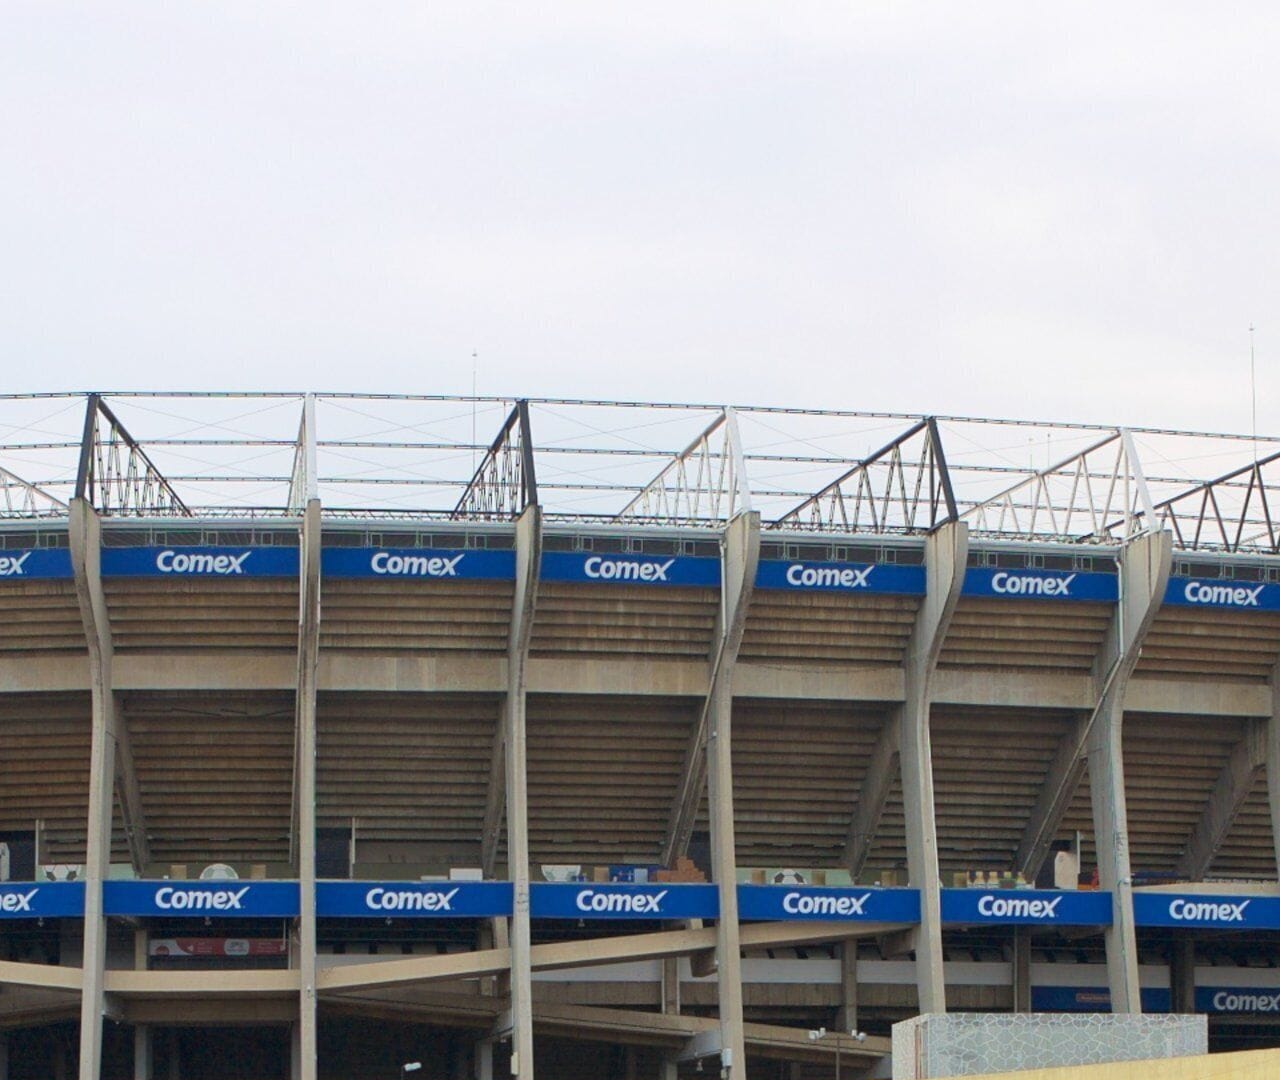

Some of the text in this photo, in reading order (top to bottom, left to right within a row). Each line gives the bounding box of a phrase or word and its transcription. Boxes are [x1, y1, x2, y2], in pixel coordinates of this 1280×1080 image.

[156, 550, 251, 574] Comex
[371, 552, 464, 576] Comex
[584, 556, 675, 580] Comex
[786, 564, 875, 588] Comex
[992, 572, 1076, 596] Comex
[1184, 582, 1264, 606] Comex
[154, 887, 250, 911] Comex
[365, 887, 459, 911] Comex
[576, 889, 668, 913] Comex
[783, 892, 871, 916] Comex
[977, 895, 1063, 919] Comex
[1168, 899, 1251, 922] Comex
